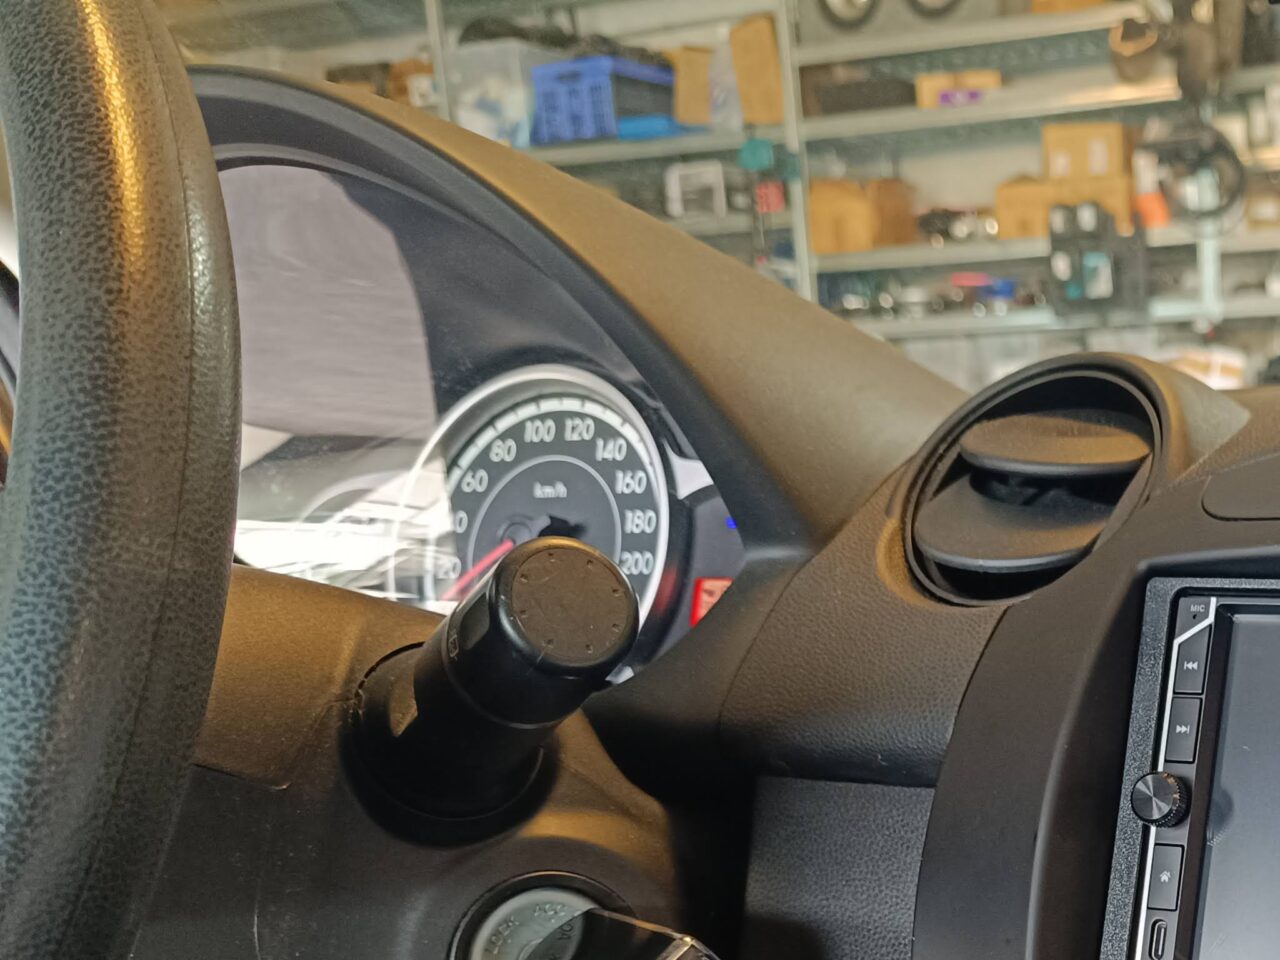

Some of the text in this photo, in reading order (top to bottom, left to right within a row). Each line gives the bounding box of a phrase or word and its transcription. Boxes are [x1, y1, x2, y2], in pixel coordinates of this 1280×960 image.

[524, 420, 556, 443] 100
[564, 417, 595, 441] 120
[489, 438, 517, 462] 80
[595, 438, 627, 461] 140
[461, 469, 488, 493] 60
[533, 481, 567, 498] km/h
[615, 470, 647, 494] 160
[624, 510, 656, 534] 180
[621, 551, 653, 575] 200
[1190, 604, 1206, 613] MIC
